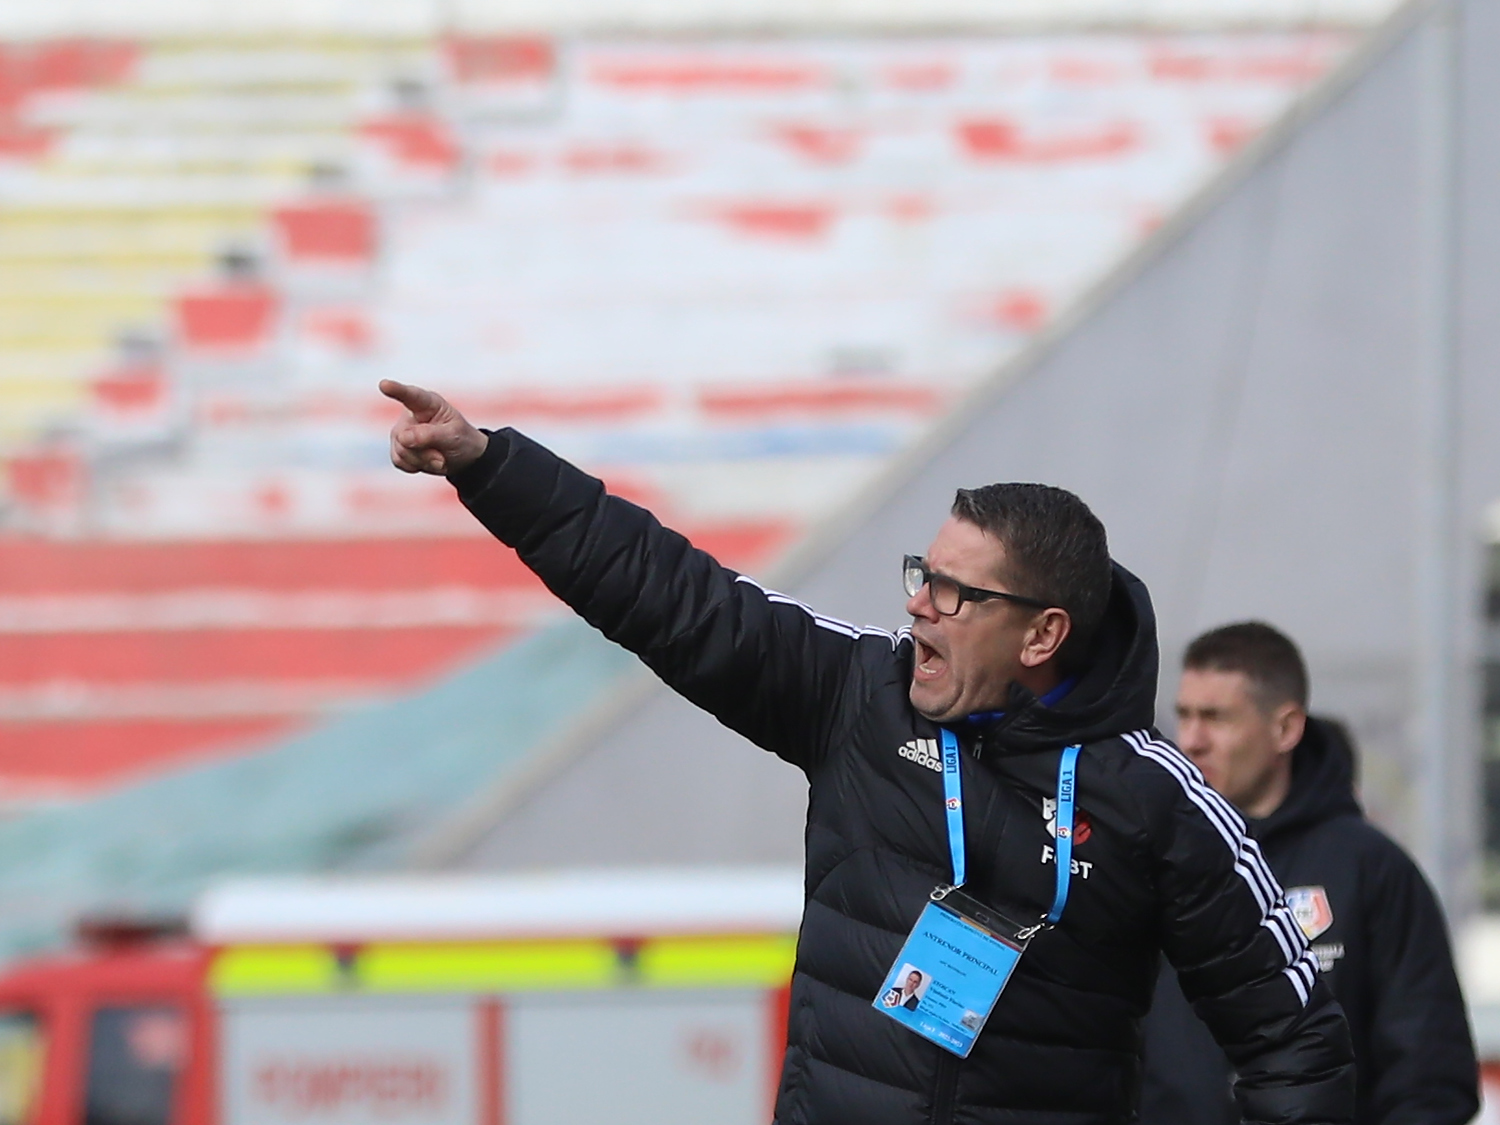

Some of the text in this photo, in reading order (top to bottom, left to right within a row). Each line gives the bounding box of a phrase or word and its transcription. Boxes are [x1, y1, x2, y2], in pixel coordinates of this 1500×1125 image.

[898, 746, 943, 772] adidas
[945, 752, 957, 774] LIGA
[1061, 778, 1073, 803] LIGA
